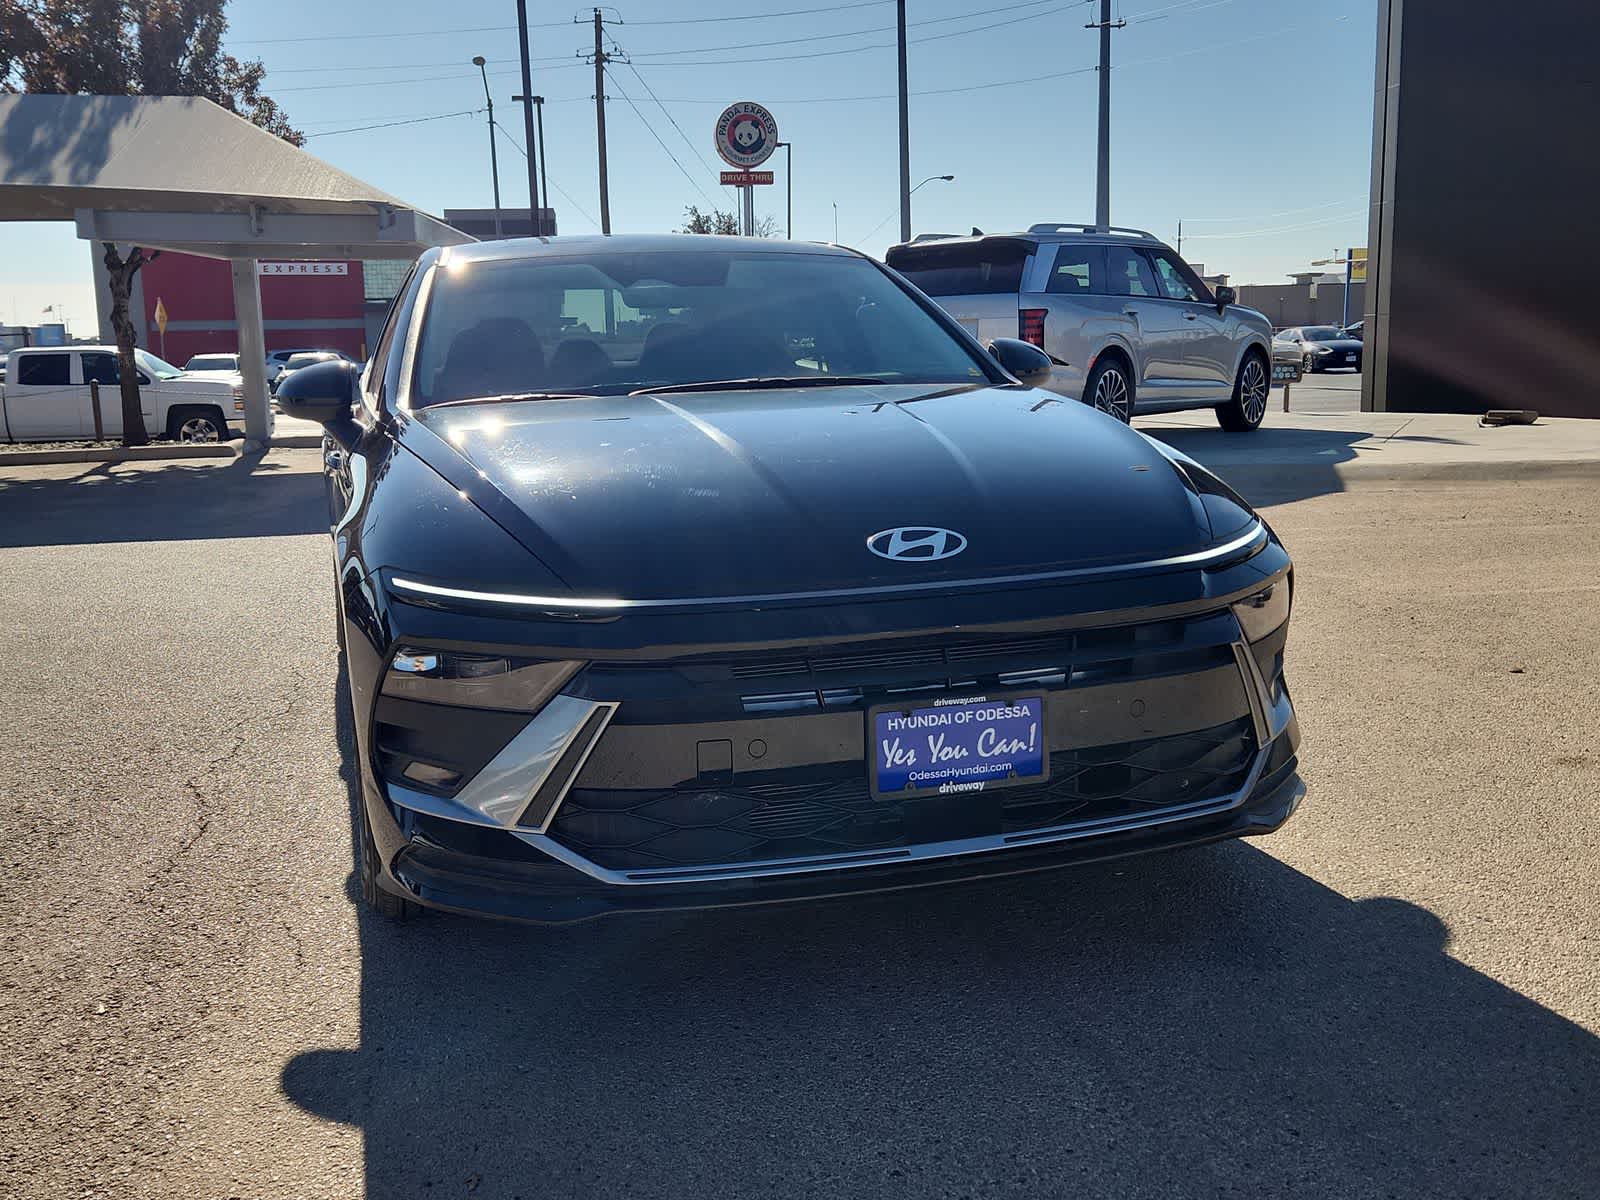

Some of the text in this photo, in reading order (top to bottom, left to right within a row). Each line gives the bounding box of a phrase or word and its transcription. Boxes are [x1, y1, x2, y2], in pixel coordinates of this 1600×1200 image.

[719, 104, 775, 136] PANDA EXPRESS
[721, 174, 773, 182] DRIVE THRU
[263, 265, 344, 273] EXPRESS
[933, 695, 987, 707] driveway.com
[887, 705, 1031, 731] HYUNDAI OF ODESSA
[882, 723, 1037, 768] Yes You Can!
[908, 762, 1013, 781] OdessaHyundai.com
[939, 781, 985, 794] driveway
